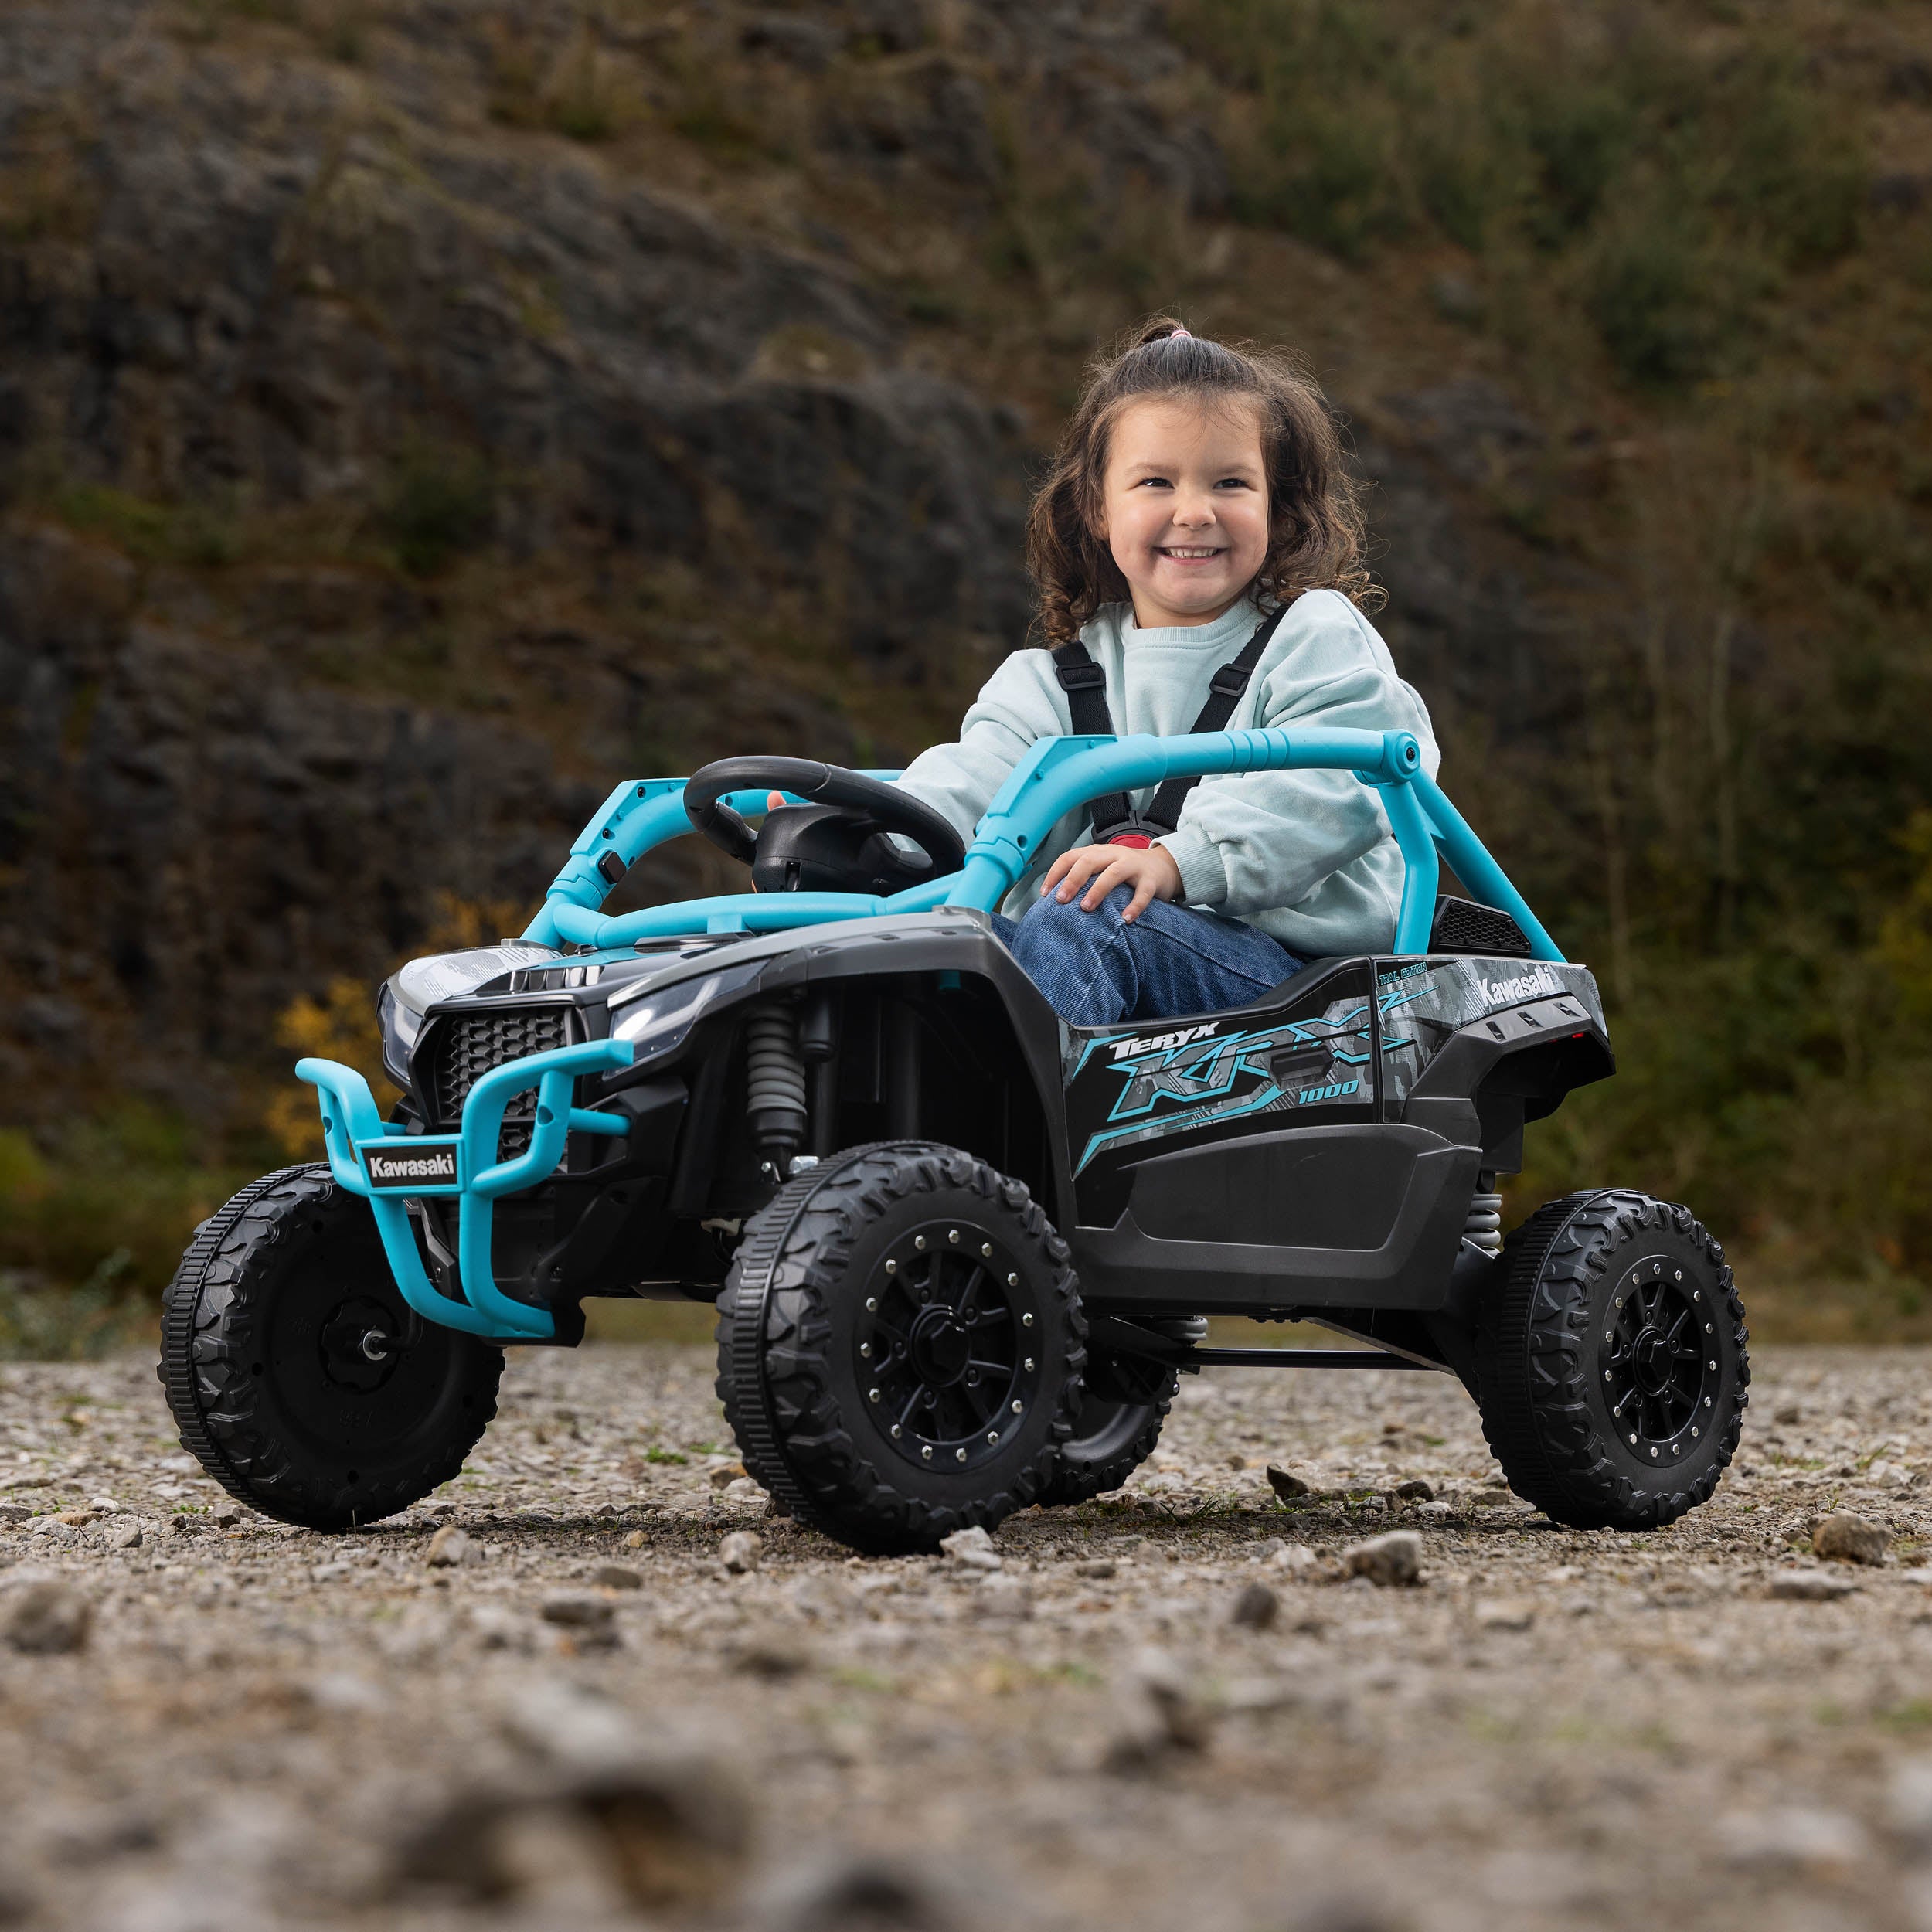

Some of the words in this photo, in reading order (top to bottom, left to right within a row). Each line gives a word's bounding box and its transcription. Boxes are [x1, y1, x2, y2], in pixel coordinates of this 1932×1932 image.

[1379, 971, 1400, 985] TRAIL
[1400, 962, 1427, 979] EDITION
[1476, 964, 1556, 1007] Kawasaki
[1109, 1022, 1220, 1060] TERYX
[1298, 1080, 1359, 1104] 1000
[370, 1154, 454, 1178] Kawasaki
